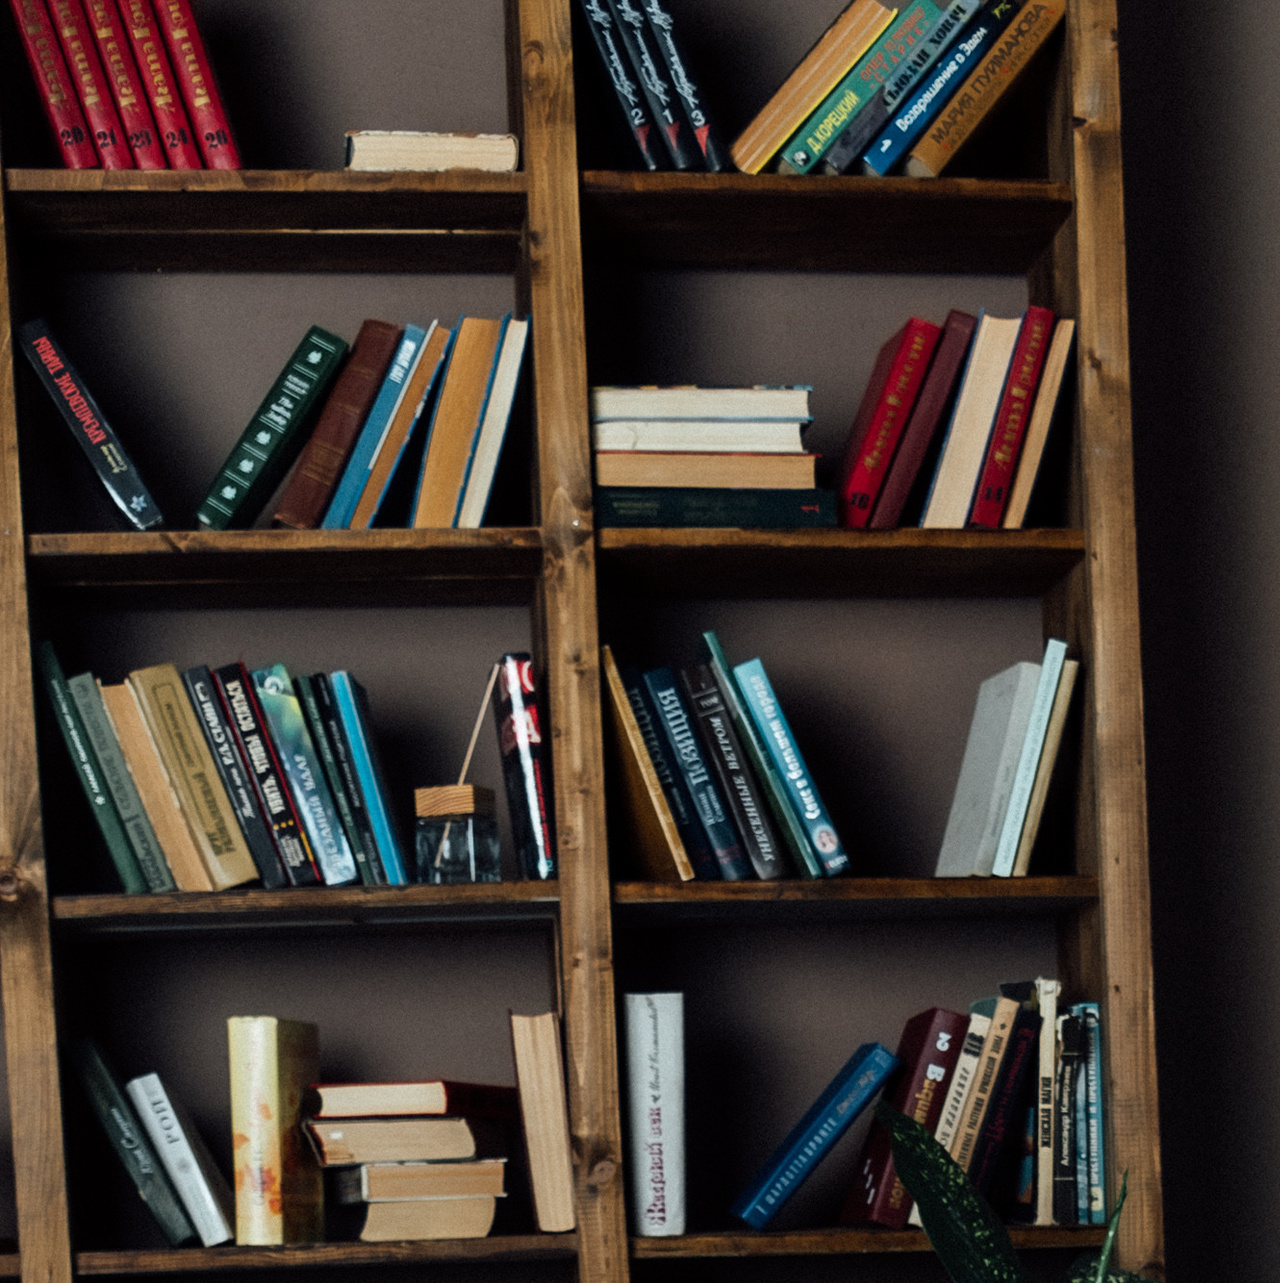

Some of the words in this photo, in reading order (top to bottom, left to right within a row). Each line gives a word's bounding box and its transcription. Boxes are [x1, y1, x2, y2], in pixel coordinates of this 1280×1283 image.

[926, 3, 968, 49] ХОВАЧ
[28, 37, 70, 113] Агата
[65, 39, 103, 112] Агата
[100, 40, 141, 117] Агата
[137, 39, 177, 118] Агата
[174, 40, 214, 117] Агата
[857, 50, 886, 82] ОПЕР
[893, 57, 962, 135] Возвращение
[957, 22, 989, 56] Эдем
[929, 91, 976, 145] МАРИЯ
[967, 0, 1048, 95] ПУЙМАНОВА
[61, 129, 85, 147] 20
[166, 130, 188, 148] 24
[631, 108, 645, 124] 2
[663, 109, 673, 124] 1
[691, 110, 705, 126] 3
[96, 131, 117, 148] 21
[130, 131, 153, 149] 23
[31, 334, 65, 375] ТАЙНЫ
[54, 370, 107, 445] КРЕМЛЕВСКИЕ
[224, 678, 256, 733] ОСТАТЬСЯ
[656, 684, 711, 786] ПОЗИЦИЯ
[709, 714, 740, 772] ВЕТРОМ
[764, 718, 803, 781] большом
[732, 773, 775, 864] УНЕСЕННЫЕ
[794, 787, 821, 821] Секс
[933, 1030, 953, 1053] 2
[1040, 1076, 1051, 1104] МАГИЯ
[801, 1116, 839, 1157] БРОНТЕ
[1040, 1107, 1051, 1147] ЖЕНСКАЯ
[1059, 1115, 1072, 1165] Александр
